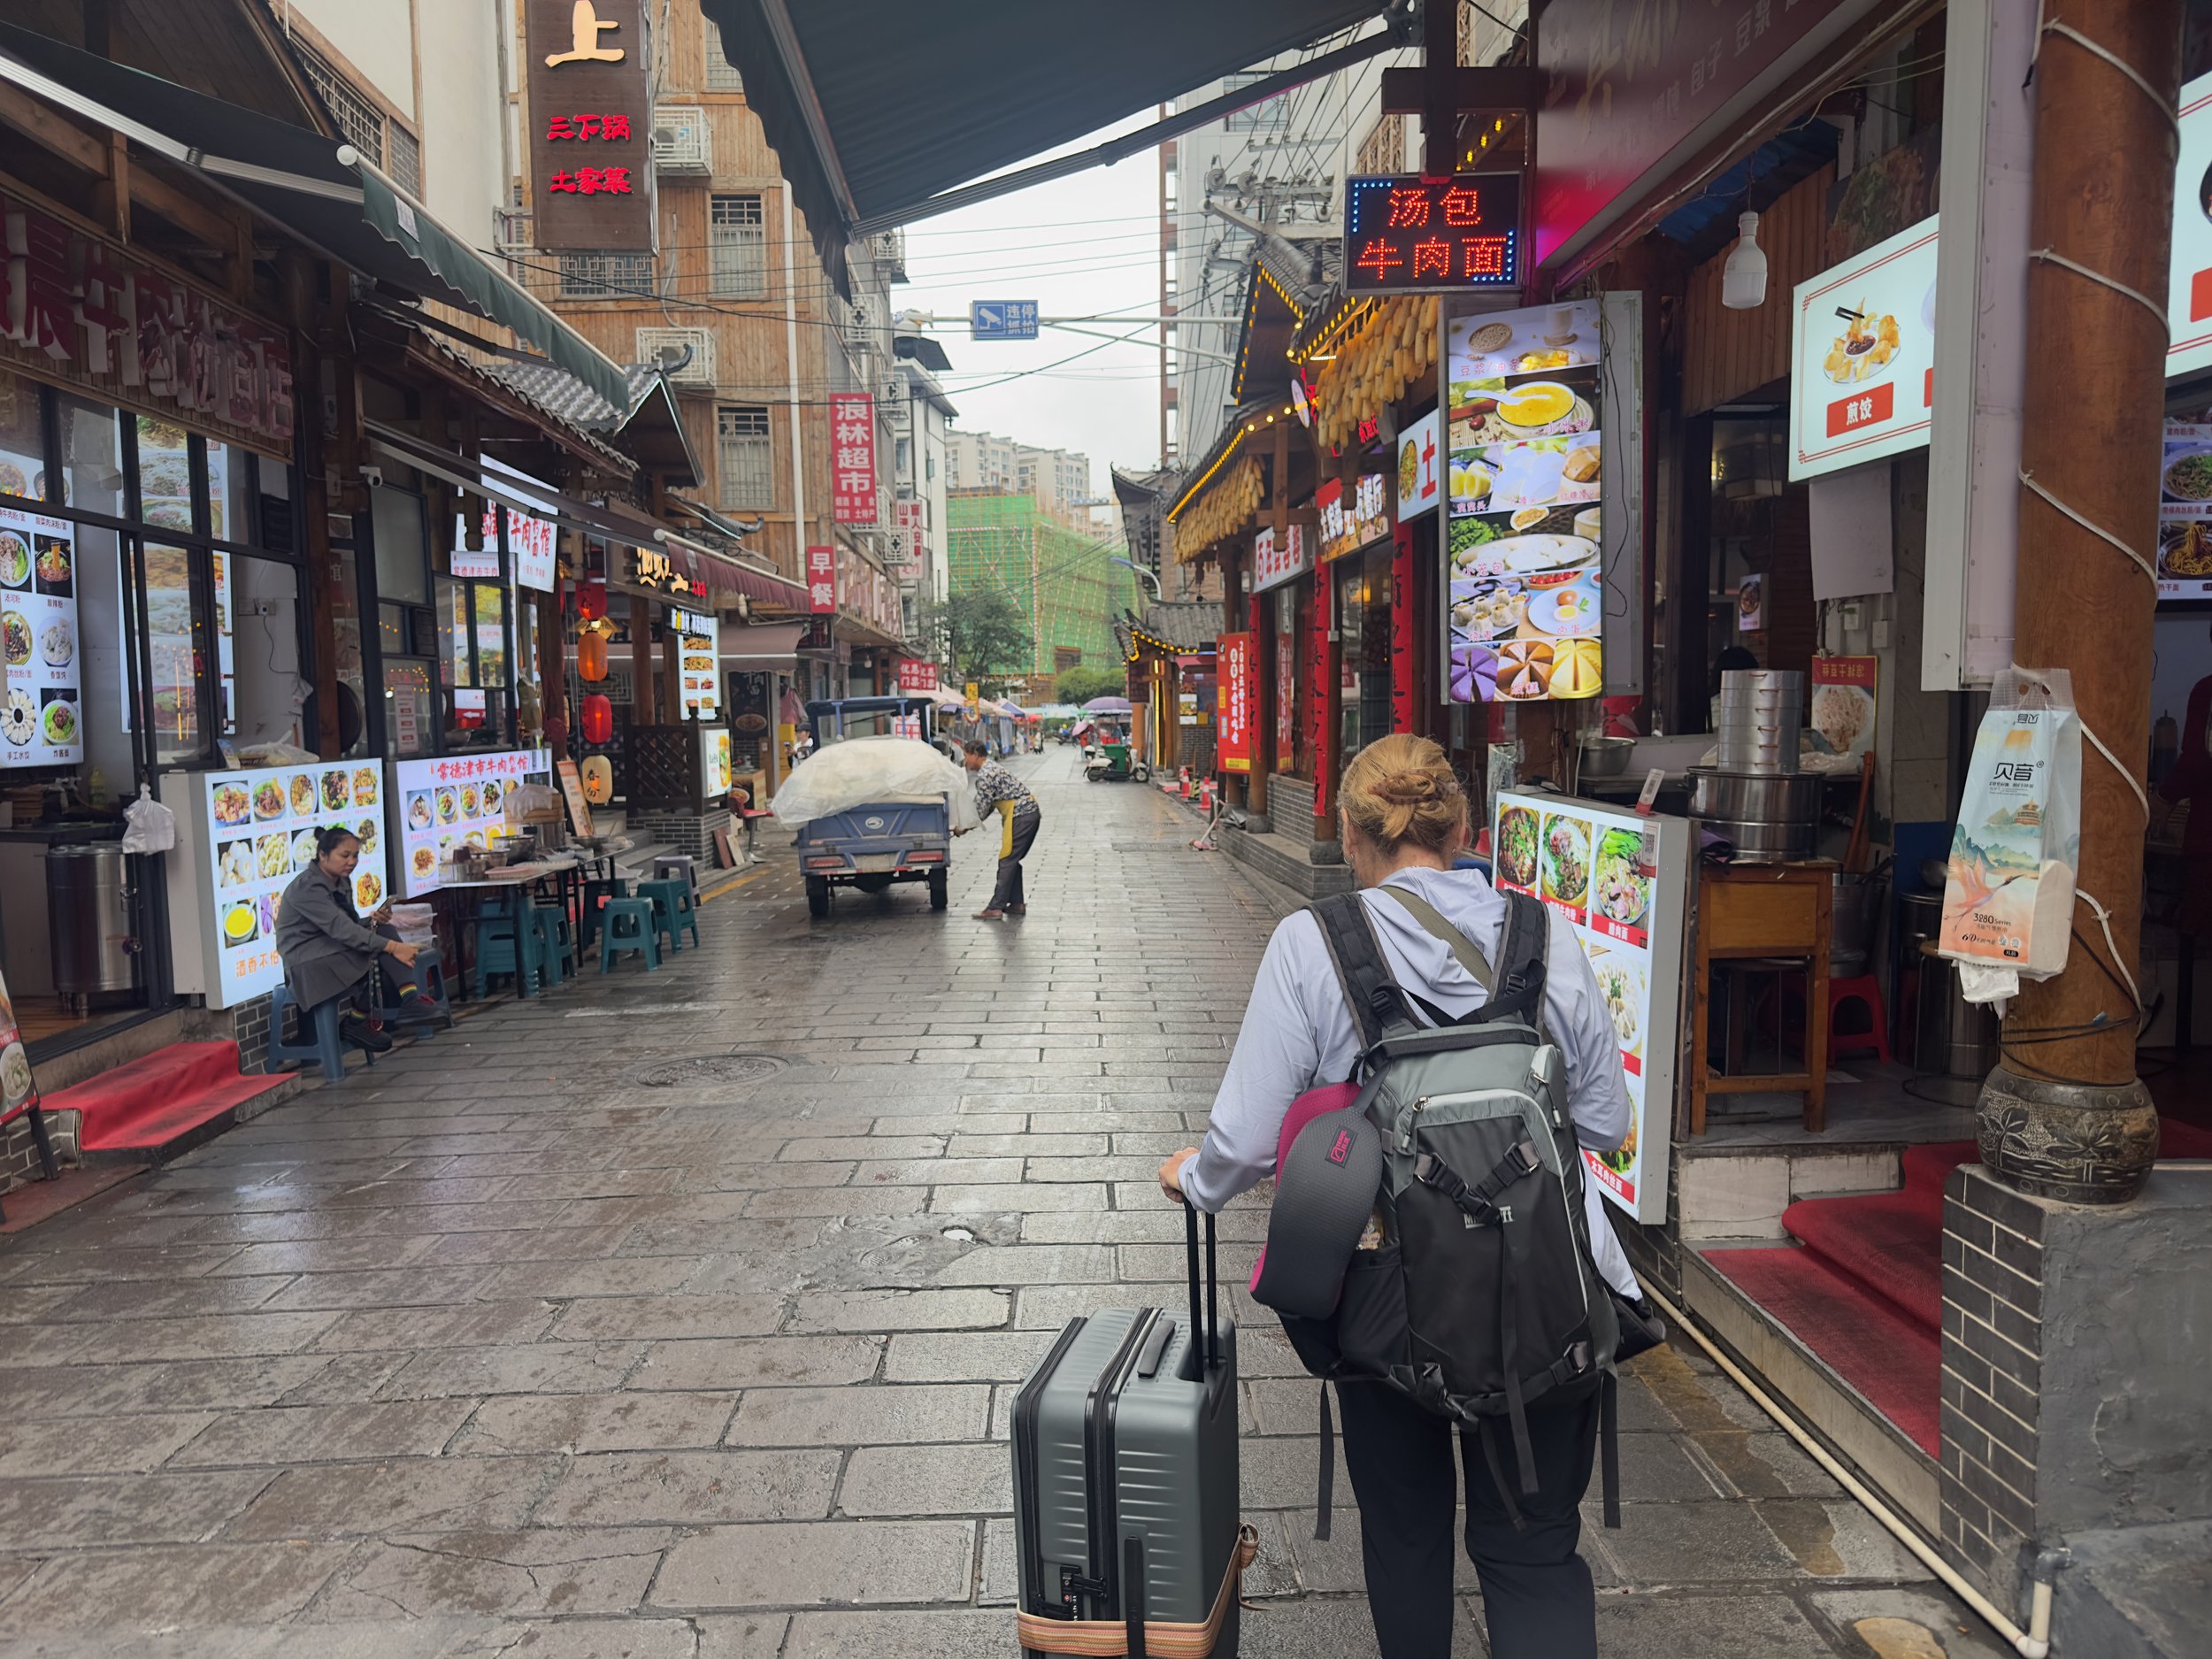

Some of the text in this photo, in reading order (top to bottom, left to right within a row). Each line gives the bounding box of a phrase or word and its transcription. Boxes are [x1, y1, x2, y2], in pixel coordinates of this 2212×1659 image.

[547, 114, 631, 142] 三下锅
[549, 167, 633, 195] 土家菜
[1388, 185, 1483, 227] 汤包
[1356, 235, 1508, 280] 牛肉面
[1007, 304, 1035, 319] 违停
[1007, 320, 1035, 335] 抓拍
[1847, 396, 1872, 425] 煎饺
[836, 398, 871, 494] 浪林超市
[855, 509, 875, 519] 土特产
[810, 552, 833, 606] 早餐
[1463, 562, 1504, 577] 小笼包
[901, 676, 920, 687] 门票
[1510, 681, 1540, 695] 发糕
[1993, 762, 2035, 781] 贝音
[1974, 912, 2012, 926] 3280 Series
[1591, 1159, 1623, 1194] 木耳肉丝面
